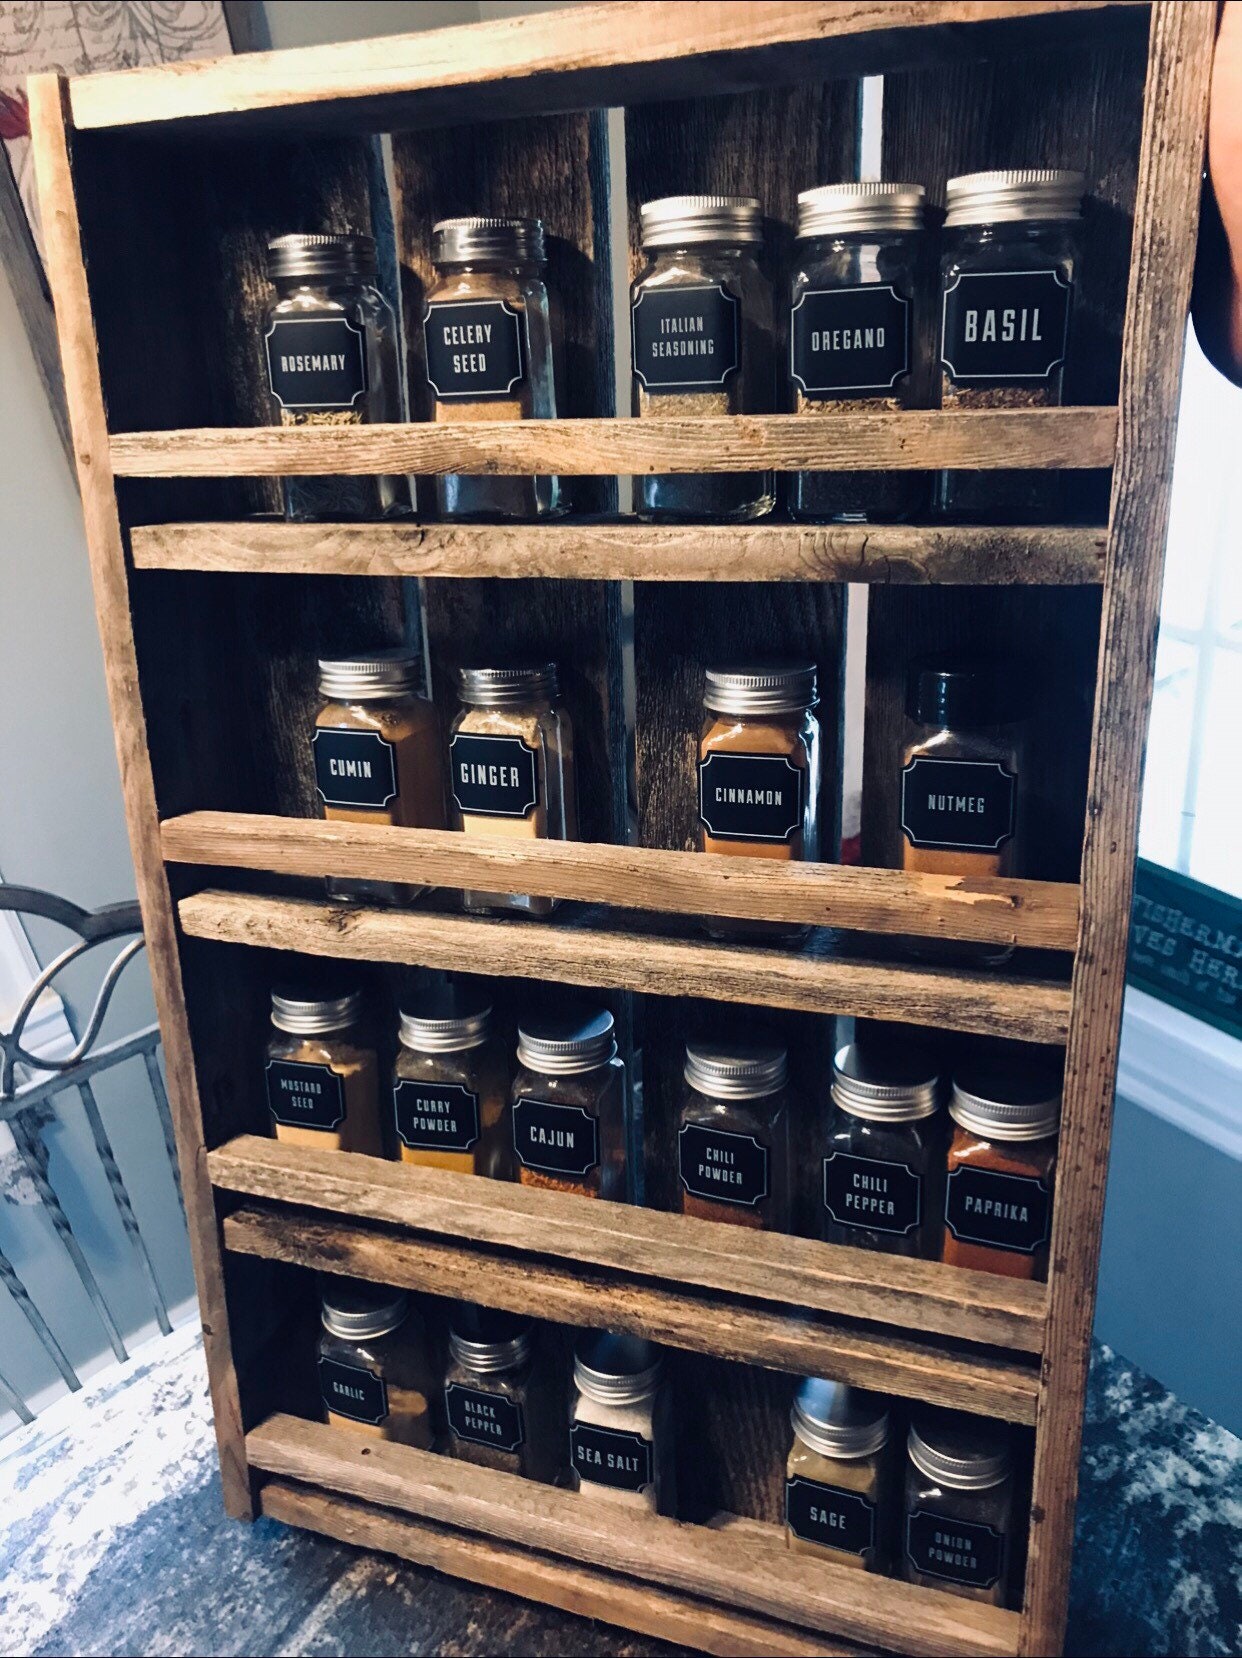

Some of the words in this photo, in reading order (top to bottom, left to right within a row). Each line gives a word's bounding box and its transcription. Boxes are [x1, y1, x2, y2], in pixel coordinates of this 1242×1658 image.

[443, 324, 492, 346] CELERY
[660, 316, 704, 334] ITALIAN
[964, 308, 1042, 342] BASIL
[652, 339, 715, 358] SEASONING
[811, 327, 886, 352] OREGANO
[281, 354, 346, 373] ROSEMARY
[453, 353, 487, 373] SEED
[329, 758, 372, 779] CUMIN
[460, 762, 520, 788] GINGER
[715, 787, 783, 806] CINNAMON
[928, 794, 985, 814] NUTMEG
[280, 1078, 323, 1095] MUSTARD
[291, 1096, 314, 1110] SEED
[416, 1098, 451, 1114] CURRY
[413, 1117, 458, 1133] POWDER
[529, 1126, 575, 1149] CAJUN
[706, 1147, 735, 1165] CHILI
[698, 1164, 743, 1186] POWDER
[852, 1173, 889, 1193] CHILI
[845, 1193, 895, 1216] PEPPER
[964, 1195, 1029, 1223] PAPRIKA
[333, 1381, 366, 1401] GARLIC
[464, 1400, 496, 1418] BLACK
[464, 1416, 503, 1436] PEPPER
[577, 1445, 602, 1465] SEA
[607, 1453, 639, 1472] SALT
[809, 1506, 847, 1530] SAGE
[934, 1531, 973, 1551] ONION
[928, 1547, 978, 1569] POWDER
